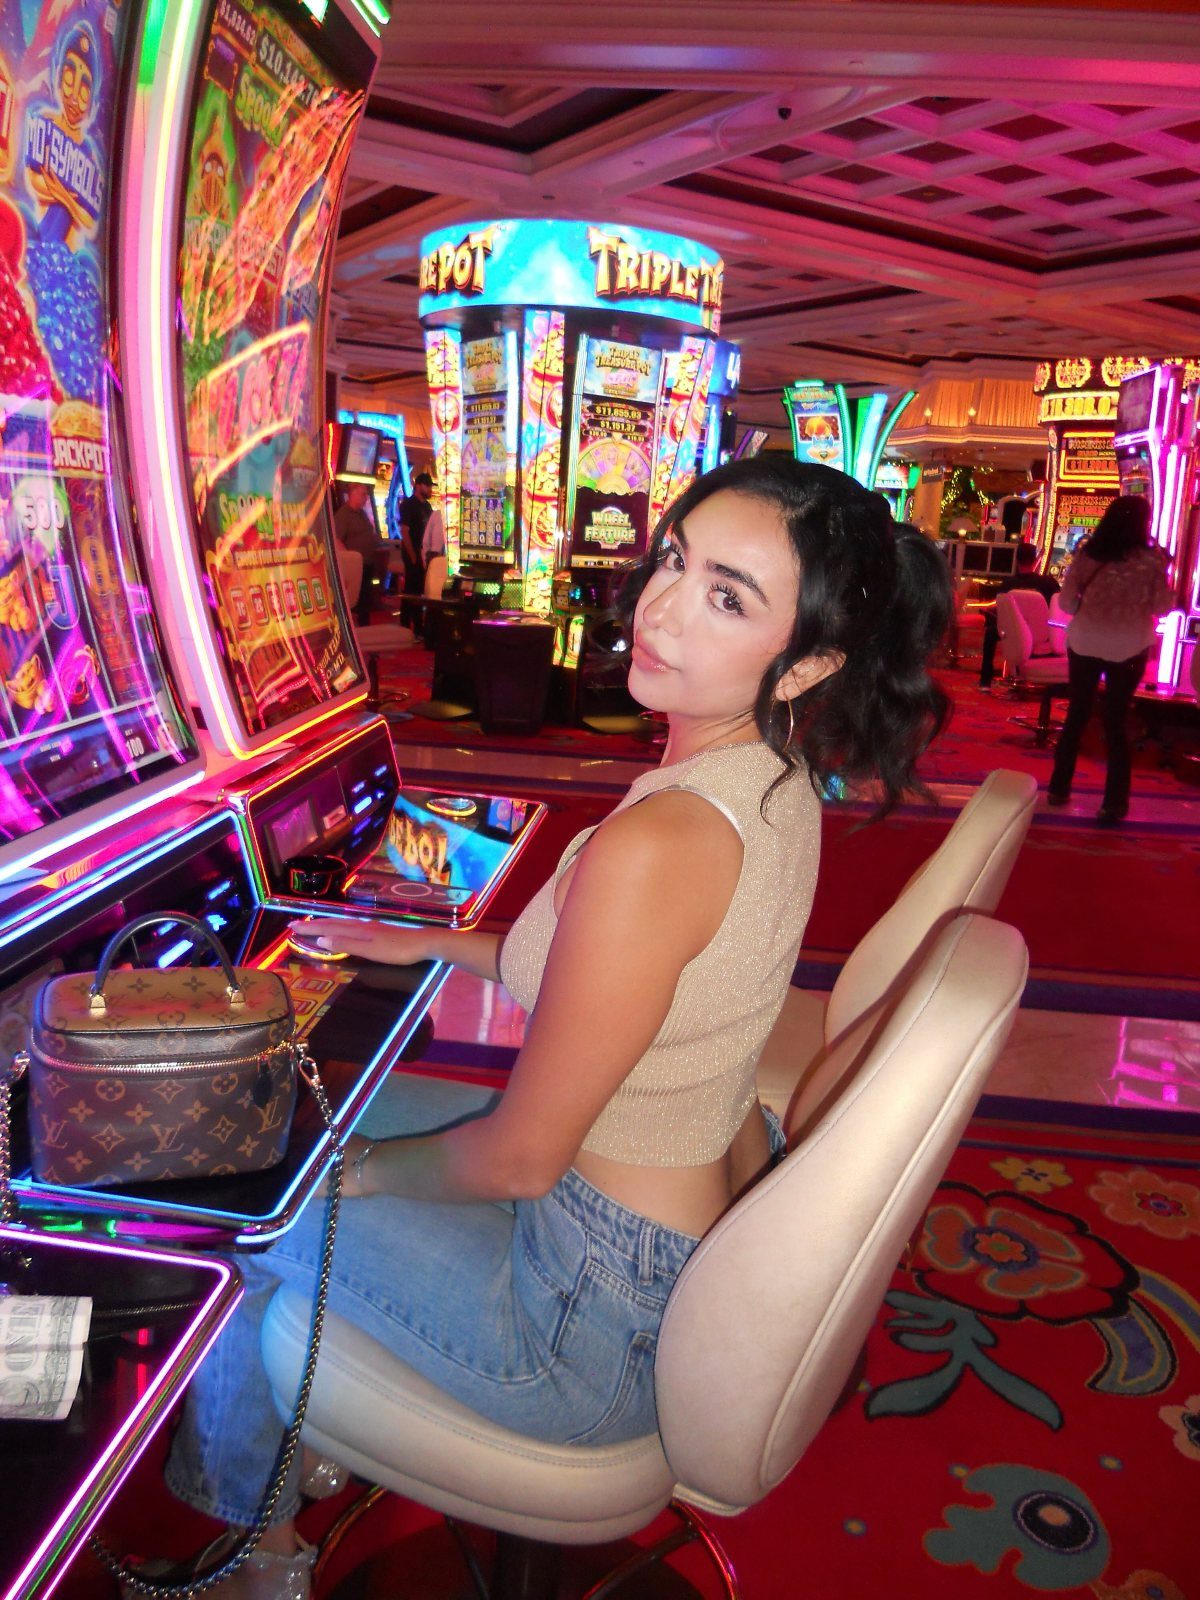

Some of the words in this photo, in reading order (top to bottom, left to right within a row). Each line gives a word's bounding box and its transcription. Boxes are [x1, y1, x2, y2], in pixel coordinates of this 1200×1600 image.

[588, 226, 699, 303] TRIPLE
[53, 438, 107, 473] JACKPOT
[592, 511, 630, 527] WHEEL
[585, 526, 636, 544] FEATURE
[126, 736, 145, 759] 100
